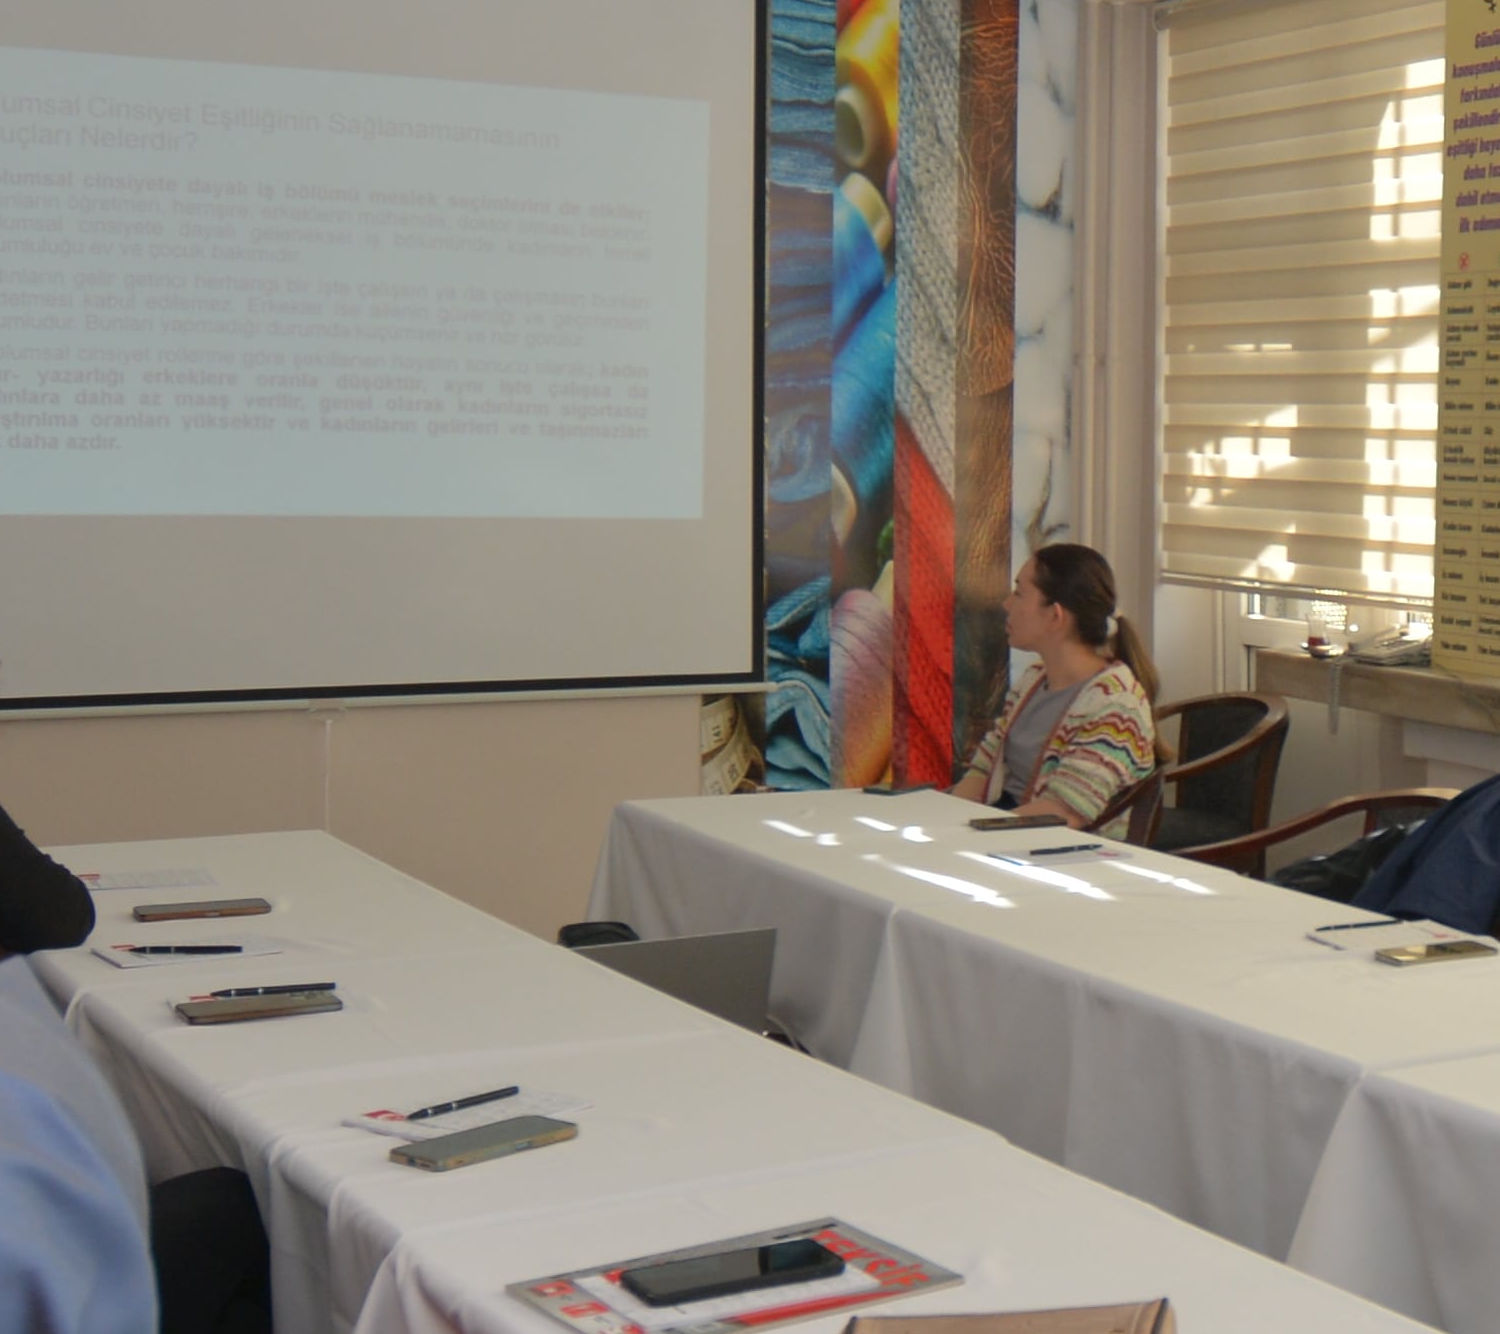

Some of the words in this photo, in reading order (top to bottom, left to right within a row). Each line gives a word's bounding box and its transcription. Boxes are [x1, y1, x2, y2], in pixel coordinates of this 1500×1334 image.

[87, 95, 191, 126] Cinsiyet
[202, 103, 321, 134] Eşitliğinin
[80, 125, 198, 152] Nelerdir?
[83, 172, 177, 196] cinsiyete
[8, 431, 59, 450] daha
